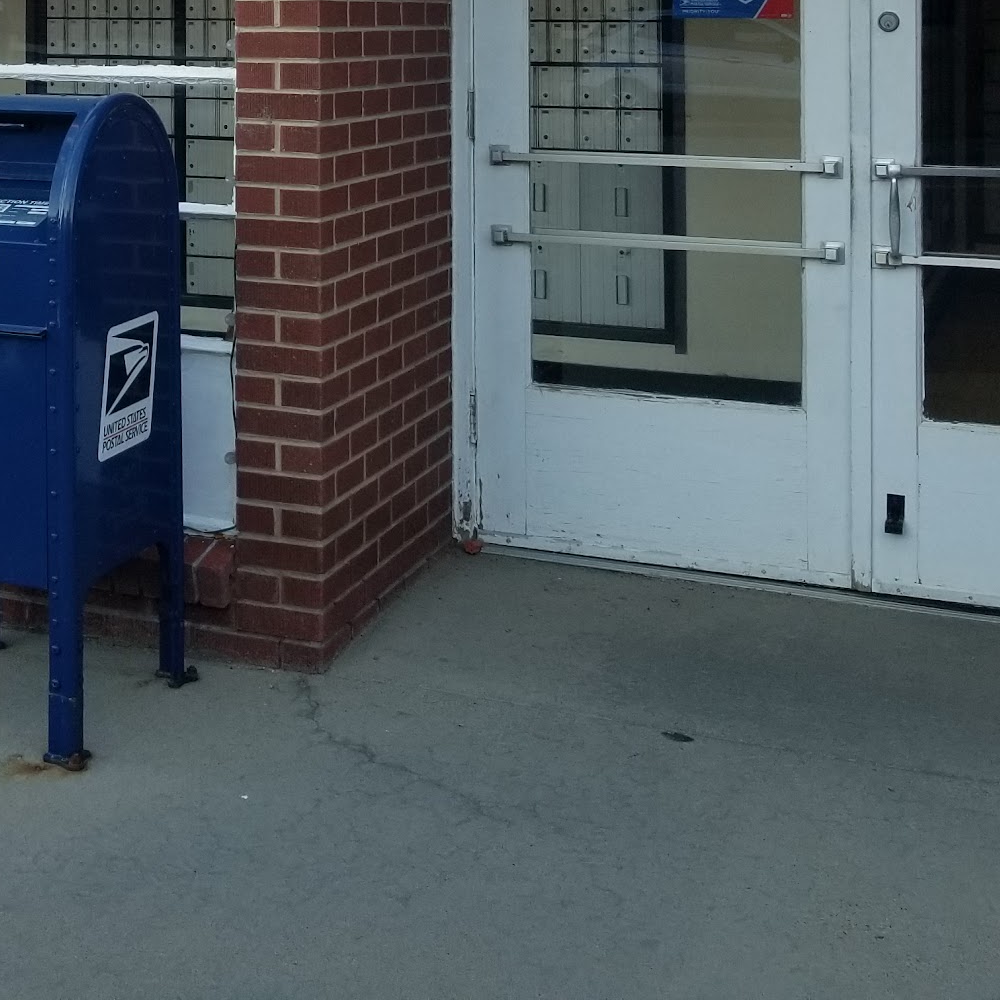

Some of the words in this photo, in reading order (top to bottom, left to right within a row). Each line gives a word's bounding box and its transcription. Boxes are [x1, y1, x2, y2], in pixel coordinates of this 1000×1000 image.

[102, 432, 125, 454] POSTAL
[125, 421, 148, 442] SERVICE
[103, 417, 127, 437] UNITED
[126, 406, 147, 426] STATES
